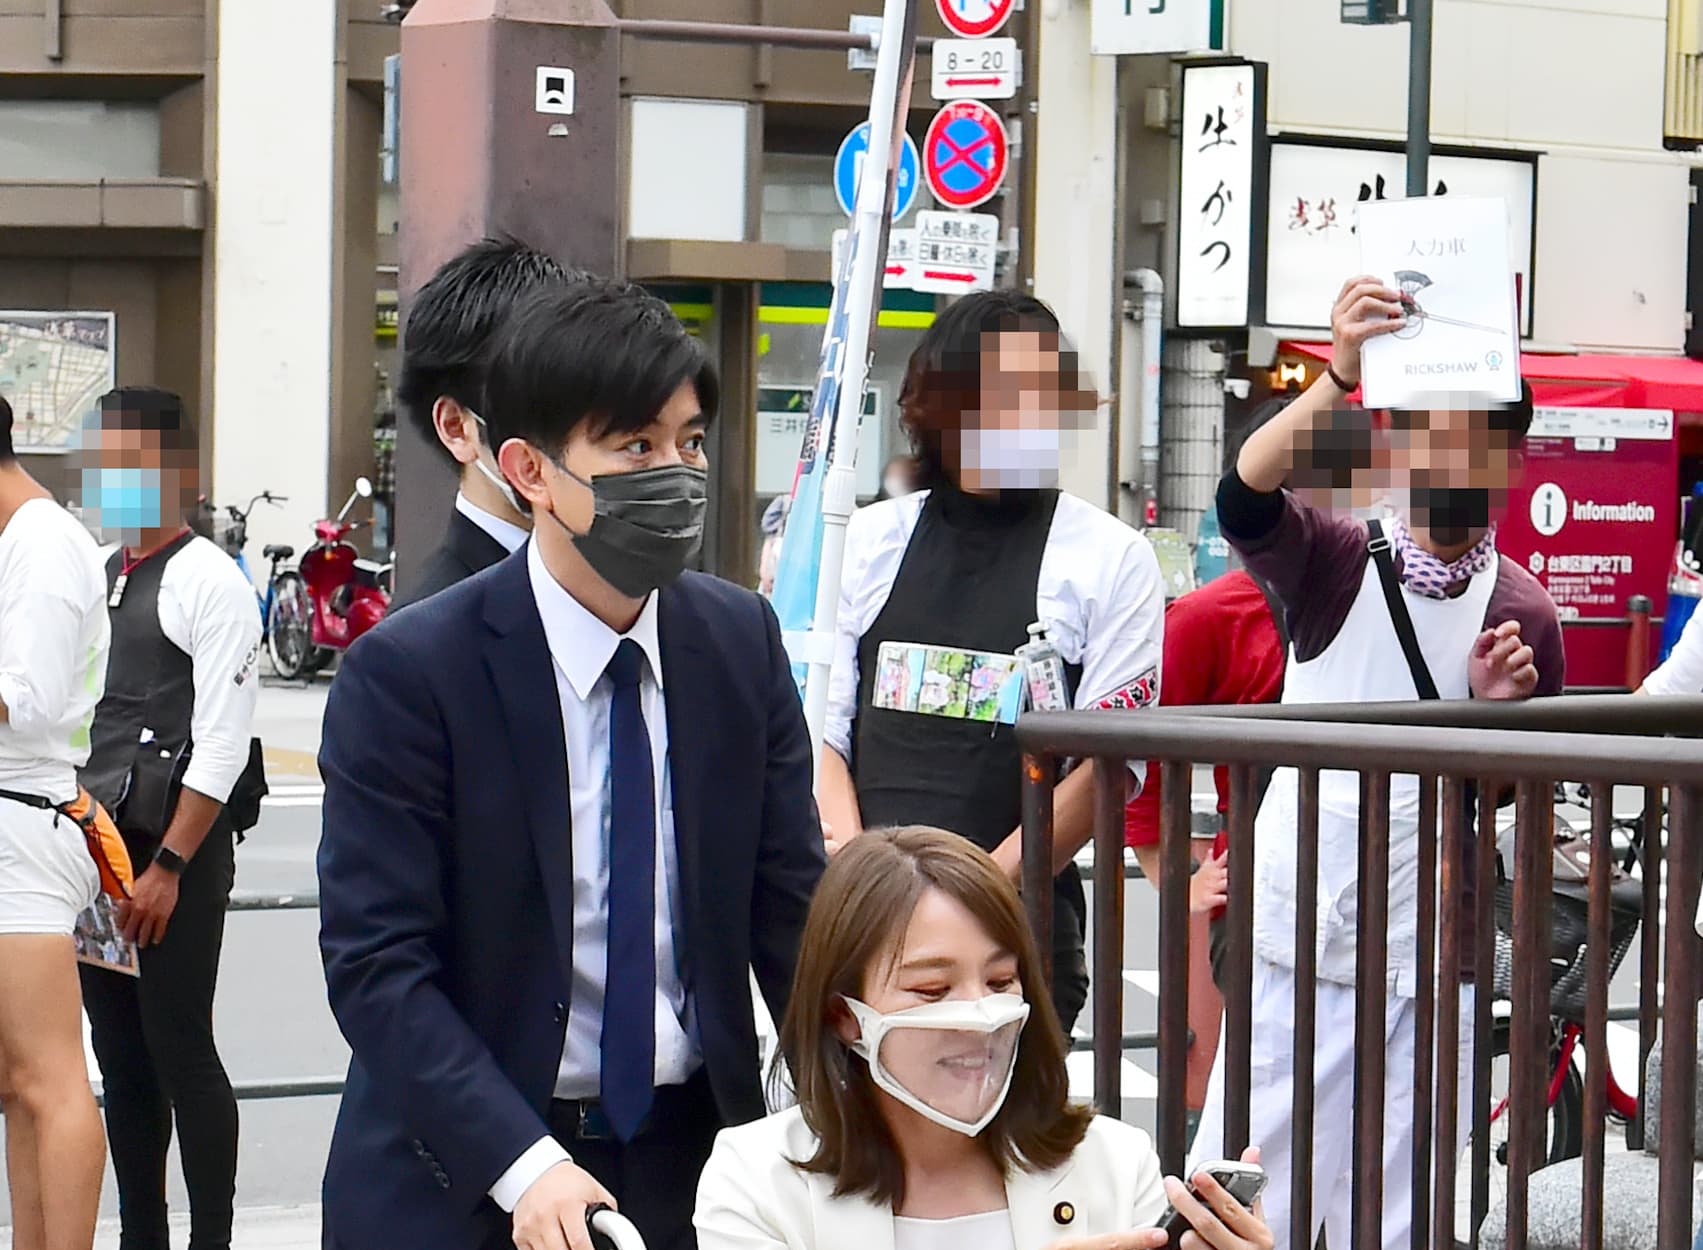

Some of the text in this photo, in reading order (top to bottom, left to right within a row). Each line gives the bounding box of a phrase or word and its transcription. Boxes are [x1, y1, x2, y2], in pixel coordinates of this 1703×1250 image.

[1197, 104, 1238, 275] 生かつ
[1407, 236, 1467, 257] 人力車
[1404, 361, 1478, 377] RICKSHAW
[1572, 499, 1656, 523] Information
